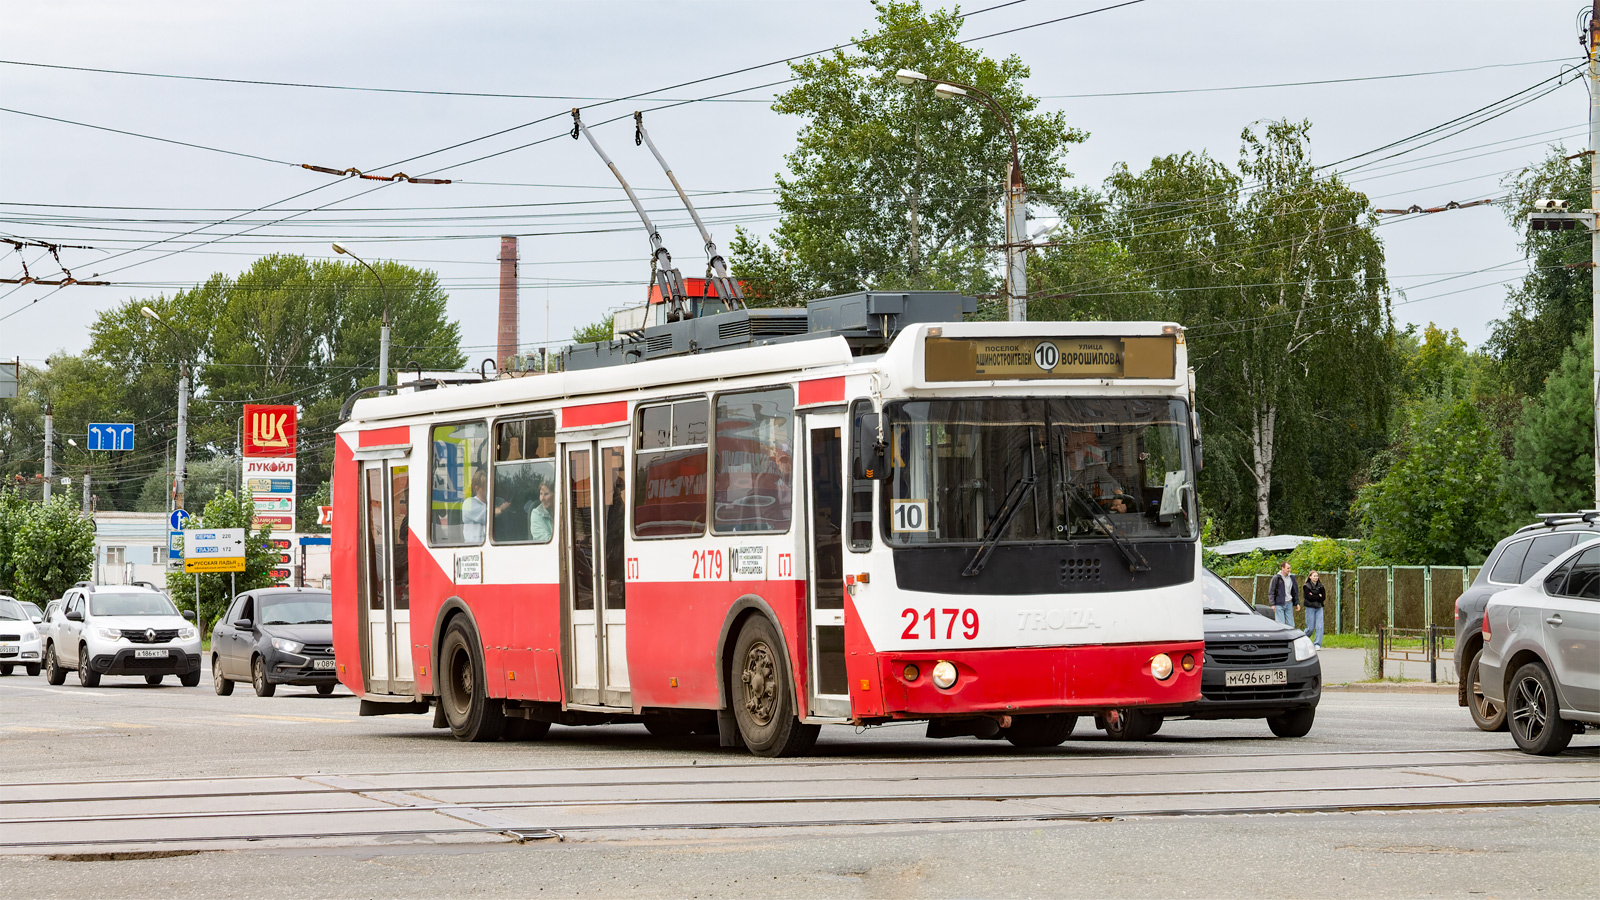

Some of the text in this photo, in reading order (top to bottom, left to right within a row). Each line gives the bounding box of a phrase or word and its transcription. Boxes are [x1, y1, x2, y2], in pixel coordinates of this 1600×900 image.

[1036, 345, 1056, 366] 10
[1061, 352, 1121, 366] ВОРОШИЛОВА
[248, 461, 294, 473] ЛУКОЙЛ
[268, 501, 275, 510] 5
[894, 504, 922, 529] 10
[692, 549, 723, 579] 2179
[732, 548, 739, 573] 10
[900, 607, 980, 640] 2179
[1273, 671, 1284, 680] 18
